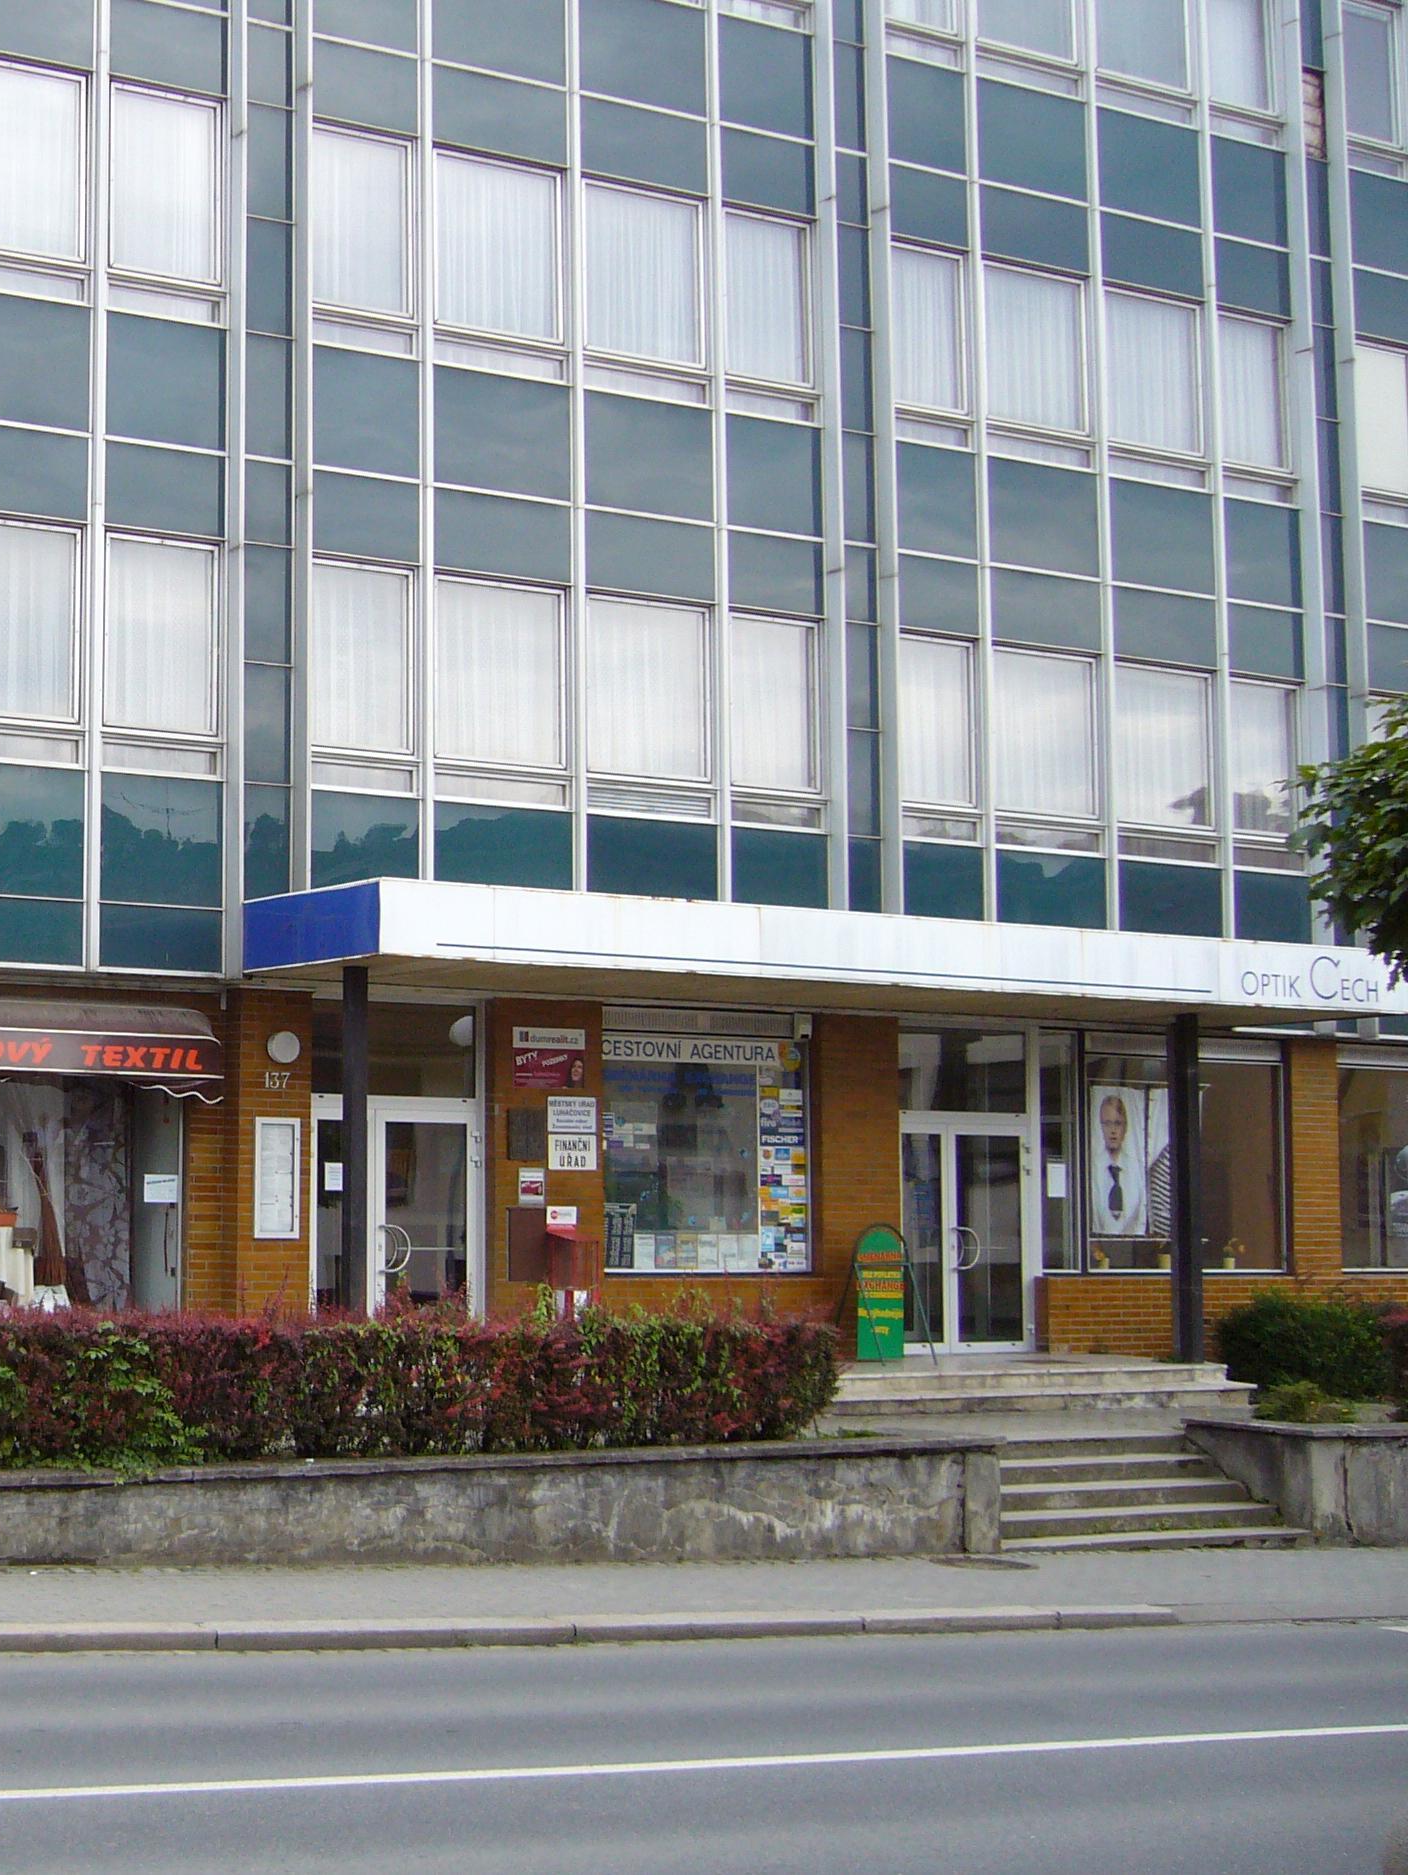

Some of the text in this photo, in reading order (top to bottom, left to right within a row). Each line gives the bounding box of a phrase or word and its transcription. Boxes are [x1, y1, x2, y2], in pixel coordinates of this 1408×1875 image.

[1241, 970, 1301, 998] OPTIK
[81, 1044, 203, 1070] TEXTIL
[515, 1051, 538, 1066] BYTY
[603, 1040, 776, 1062] CESTOVNÍ AGENTURA
[265, 1071, 290, 1089] 137
[554, 1137, 591, 1152] FINANČNÍ
[761, 1135, 799, 1144] FISCHER
